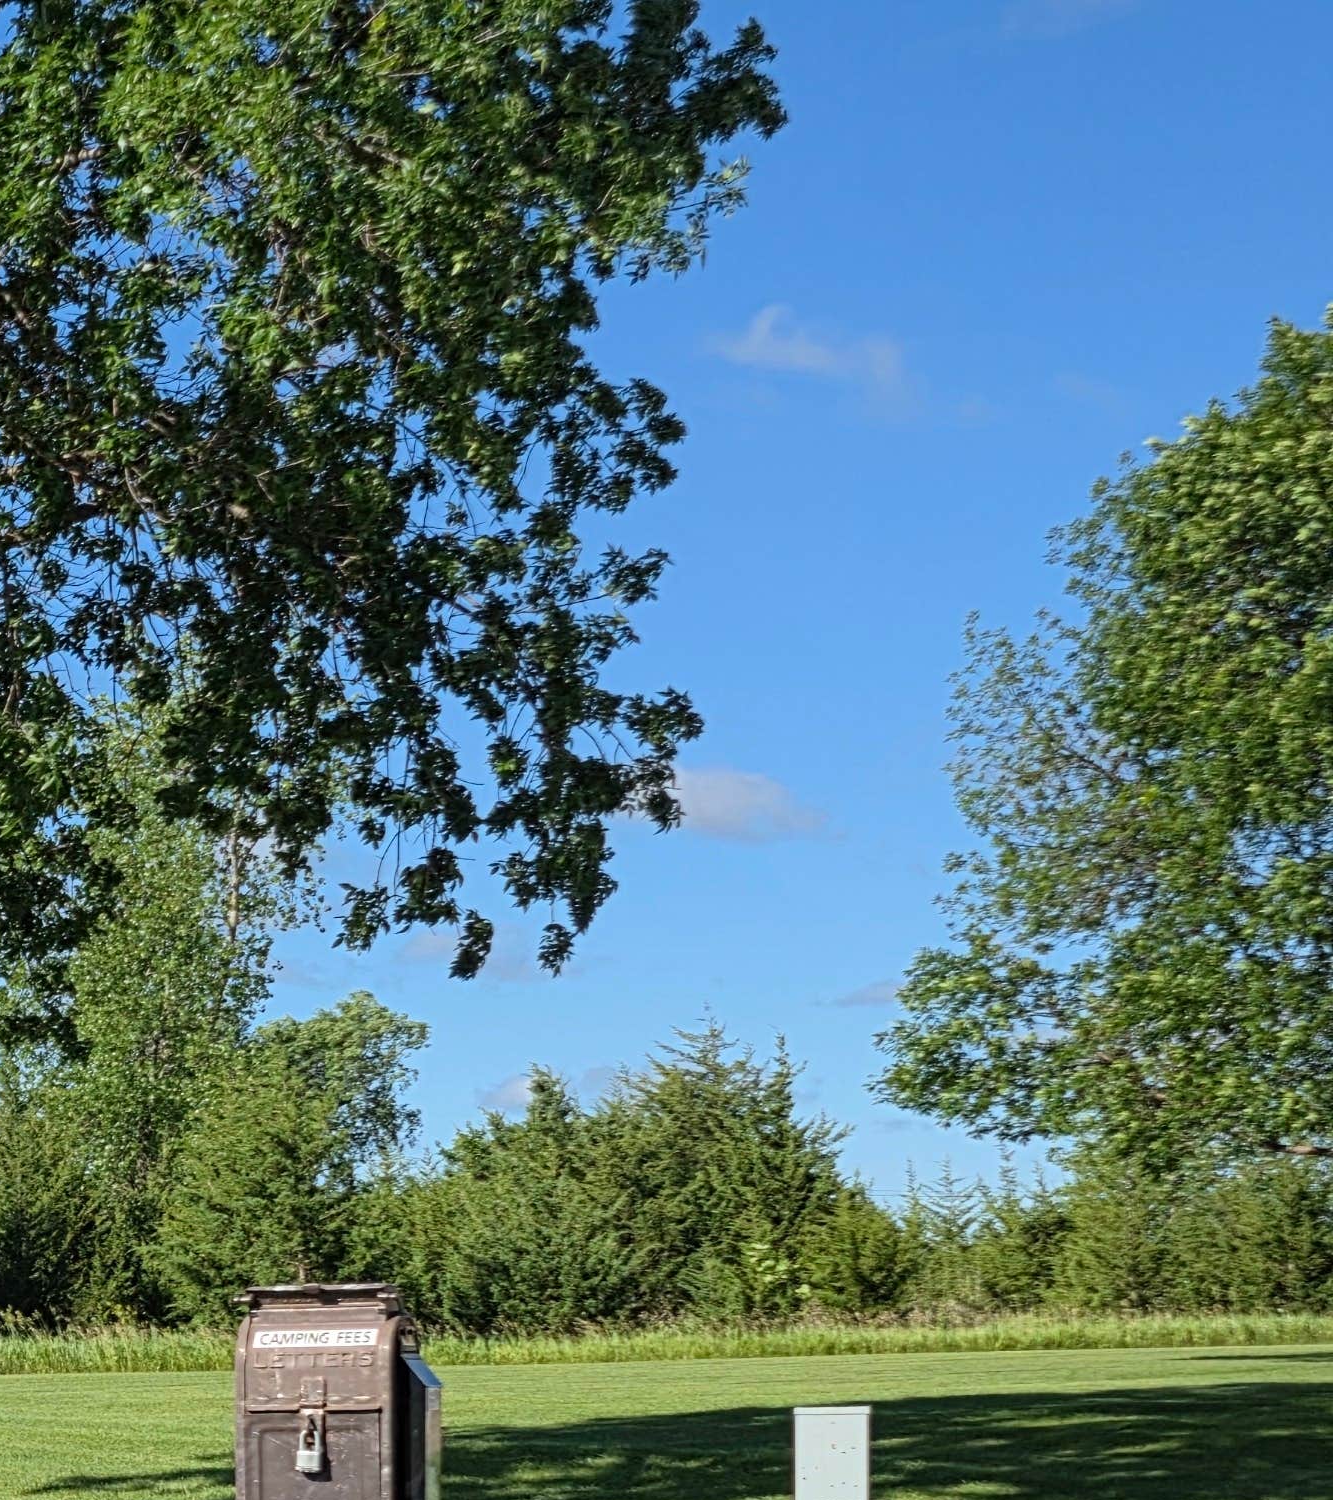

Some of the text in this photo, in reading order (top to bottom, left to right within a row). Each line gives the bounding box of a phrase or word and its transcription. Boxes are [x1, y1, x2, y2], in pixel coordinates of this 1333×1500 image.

[259, 1331, 371, 1346] CAMPING FEES
[252, 1352, 374, 1369] LETTERS
